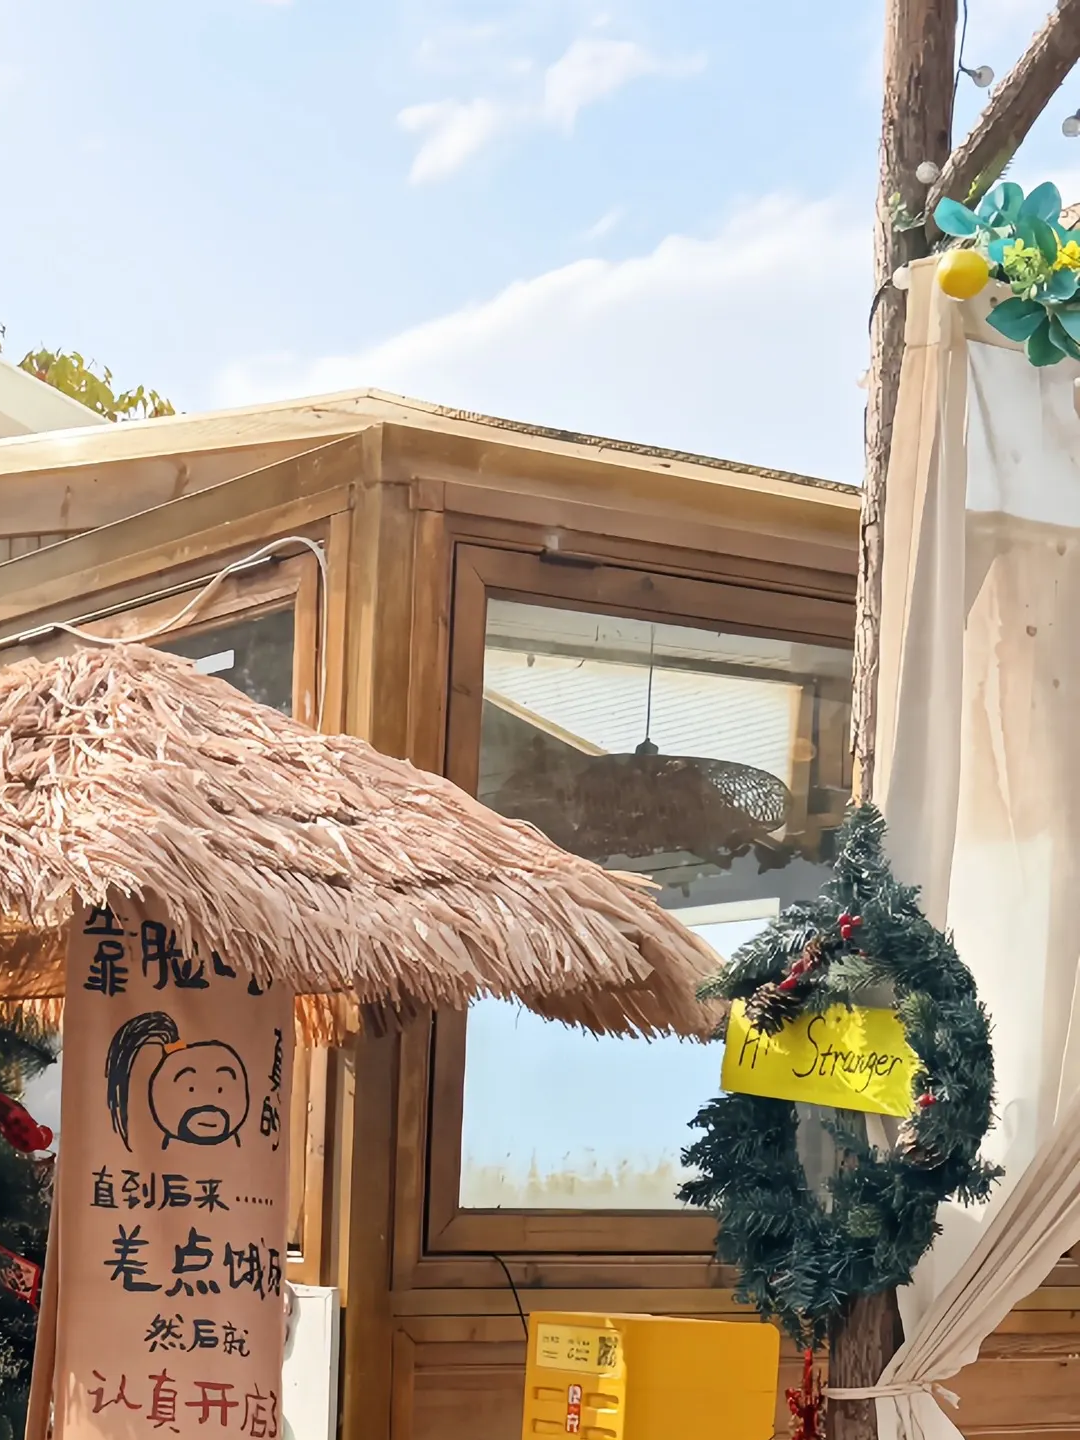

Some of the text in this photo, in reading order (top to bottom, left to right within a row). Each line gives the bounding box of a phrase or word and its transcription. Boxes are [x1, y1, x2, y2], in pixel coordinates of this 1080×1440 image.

[83, 904, 274, 998] 靠脸
[791, 1015, 903, 1093] Stranger
[143, 1312, 250, 1357] 然后就
